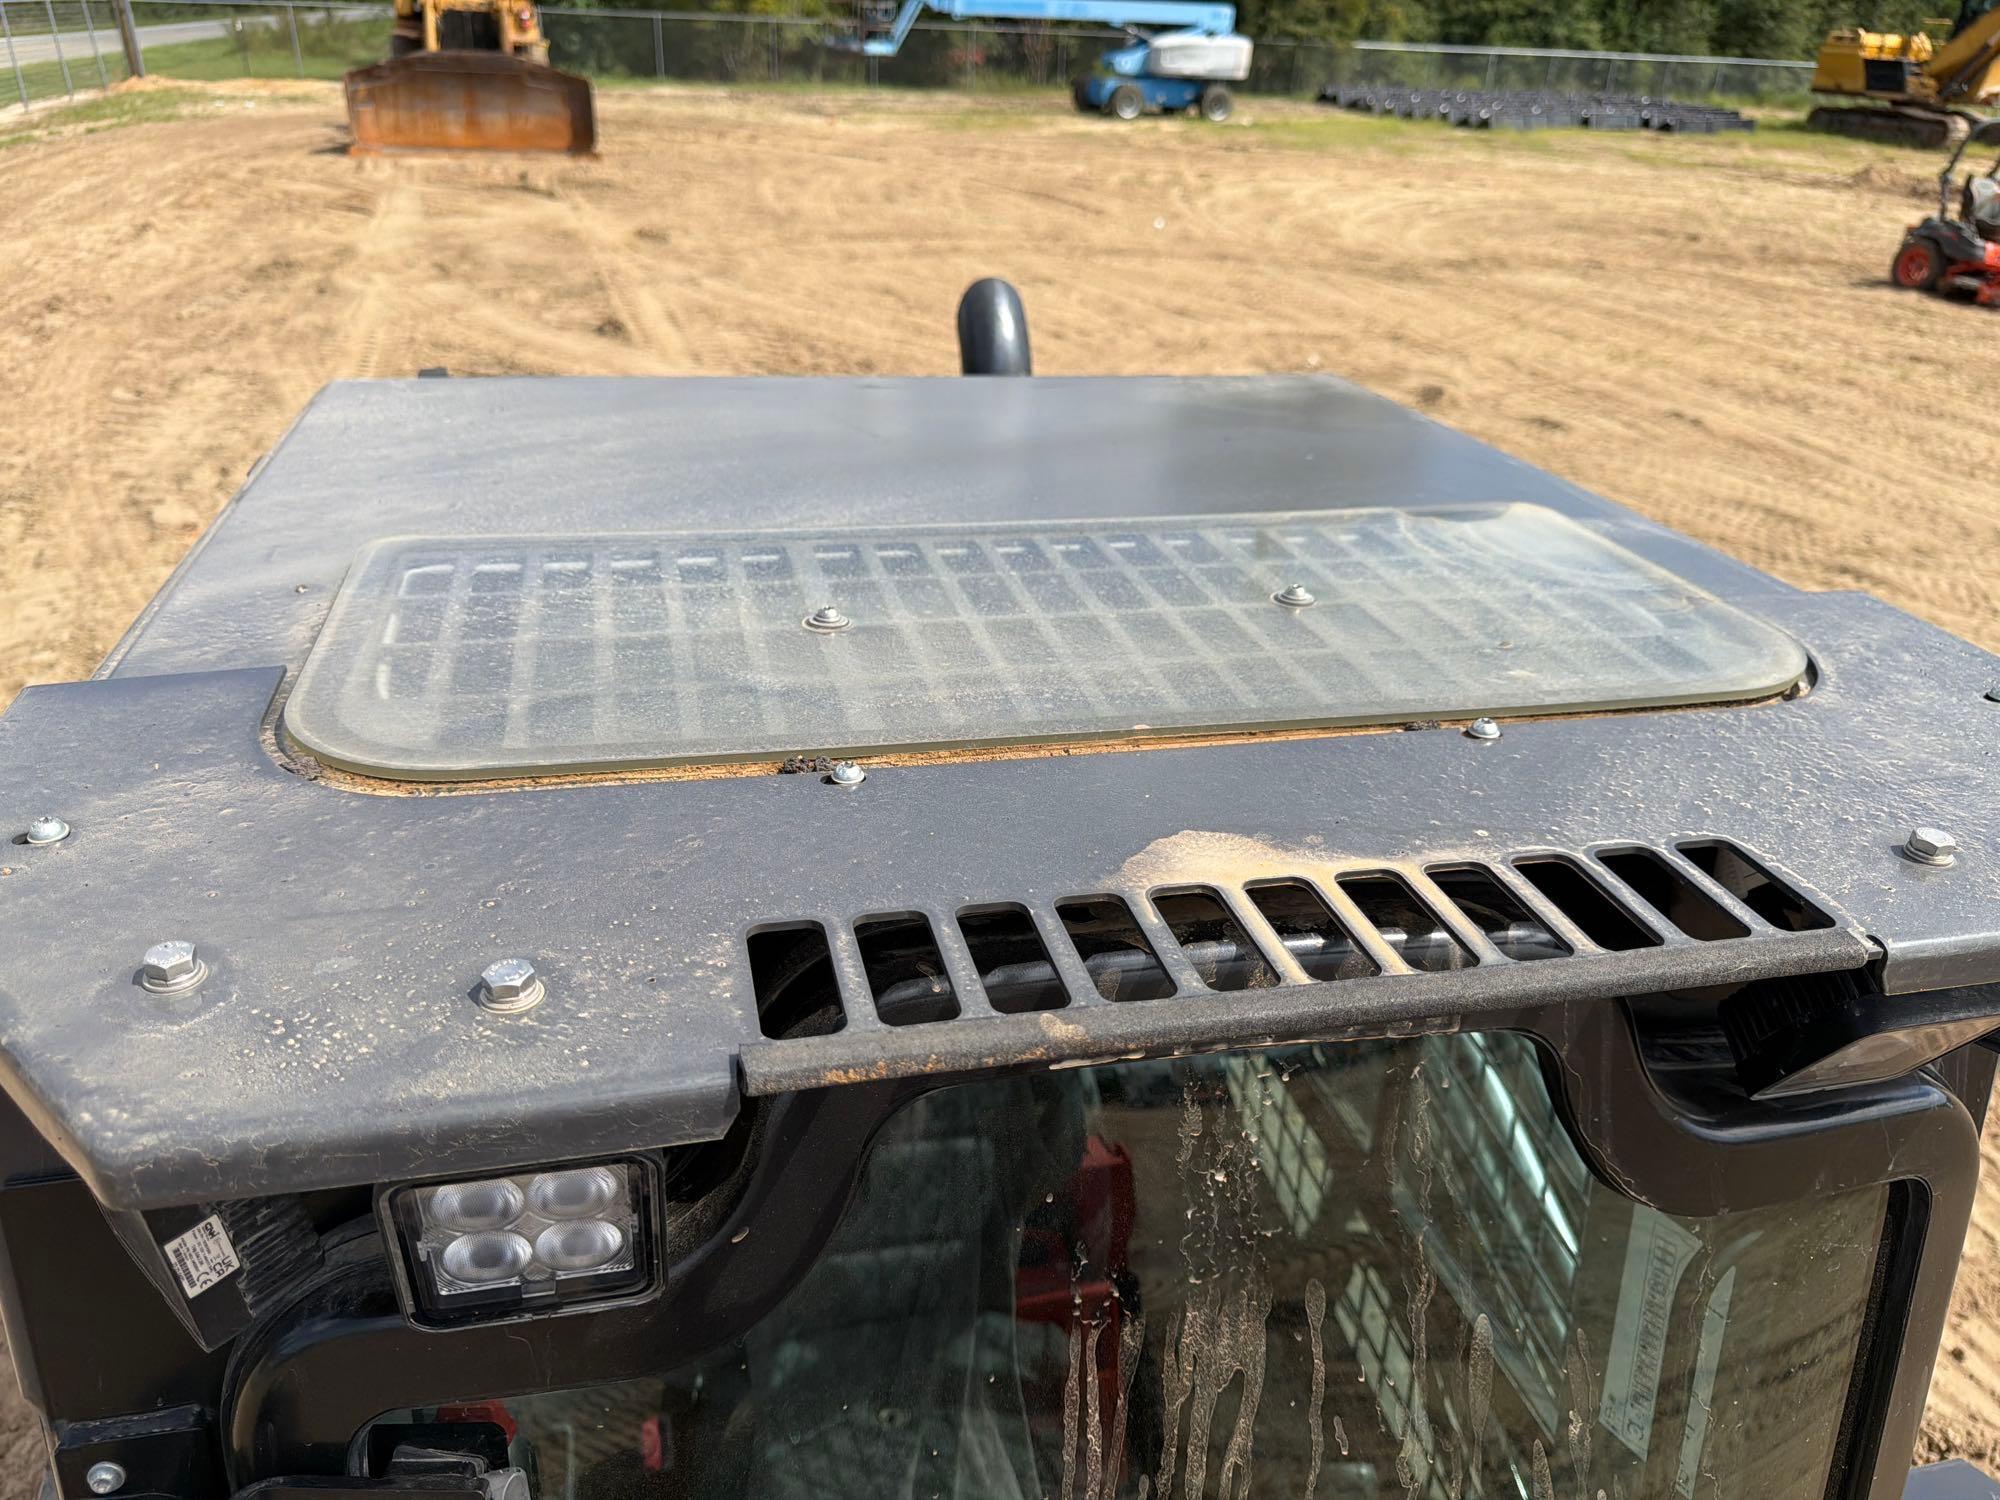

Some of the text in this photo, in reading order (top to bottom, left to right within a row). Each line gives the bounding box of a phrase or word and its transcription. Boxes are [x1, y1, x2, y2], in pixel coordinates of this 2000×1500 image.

[213, 1262, 225, 1278] CA
[222, 1255, 235, 1272] UK
[197, 1272, 213, 1289] CE
